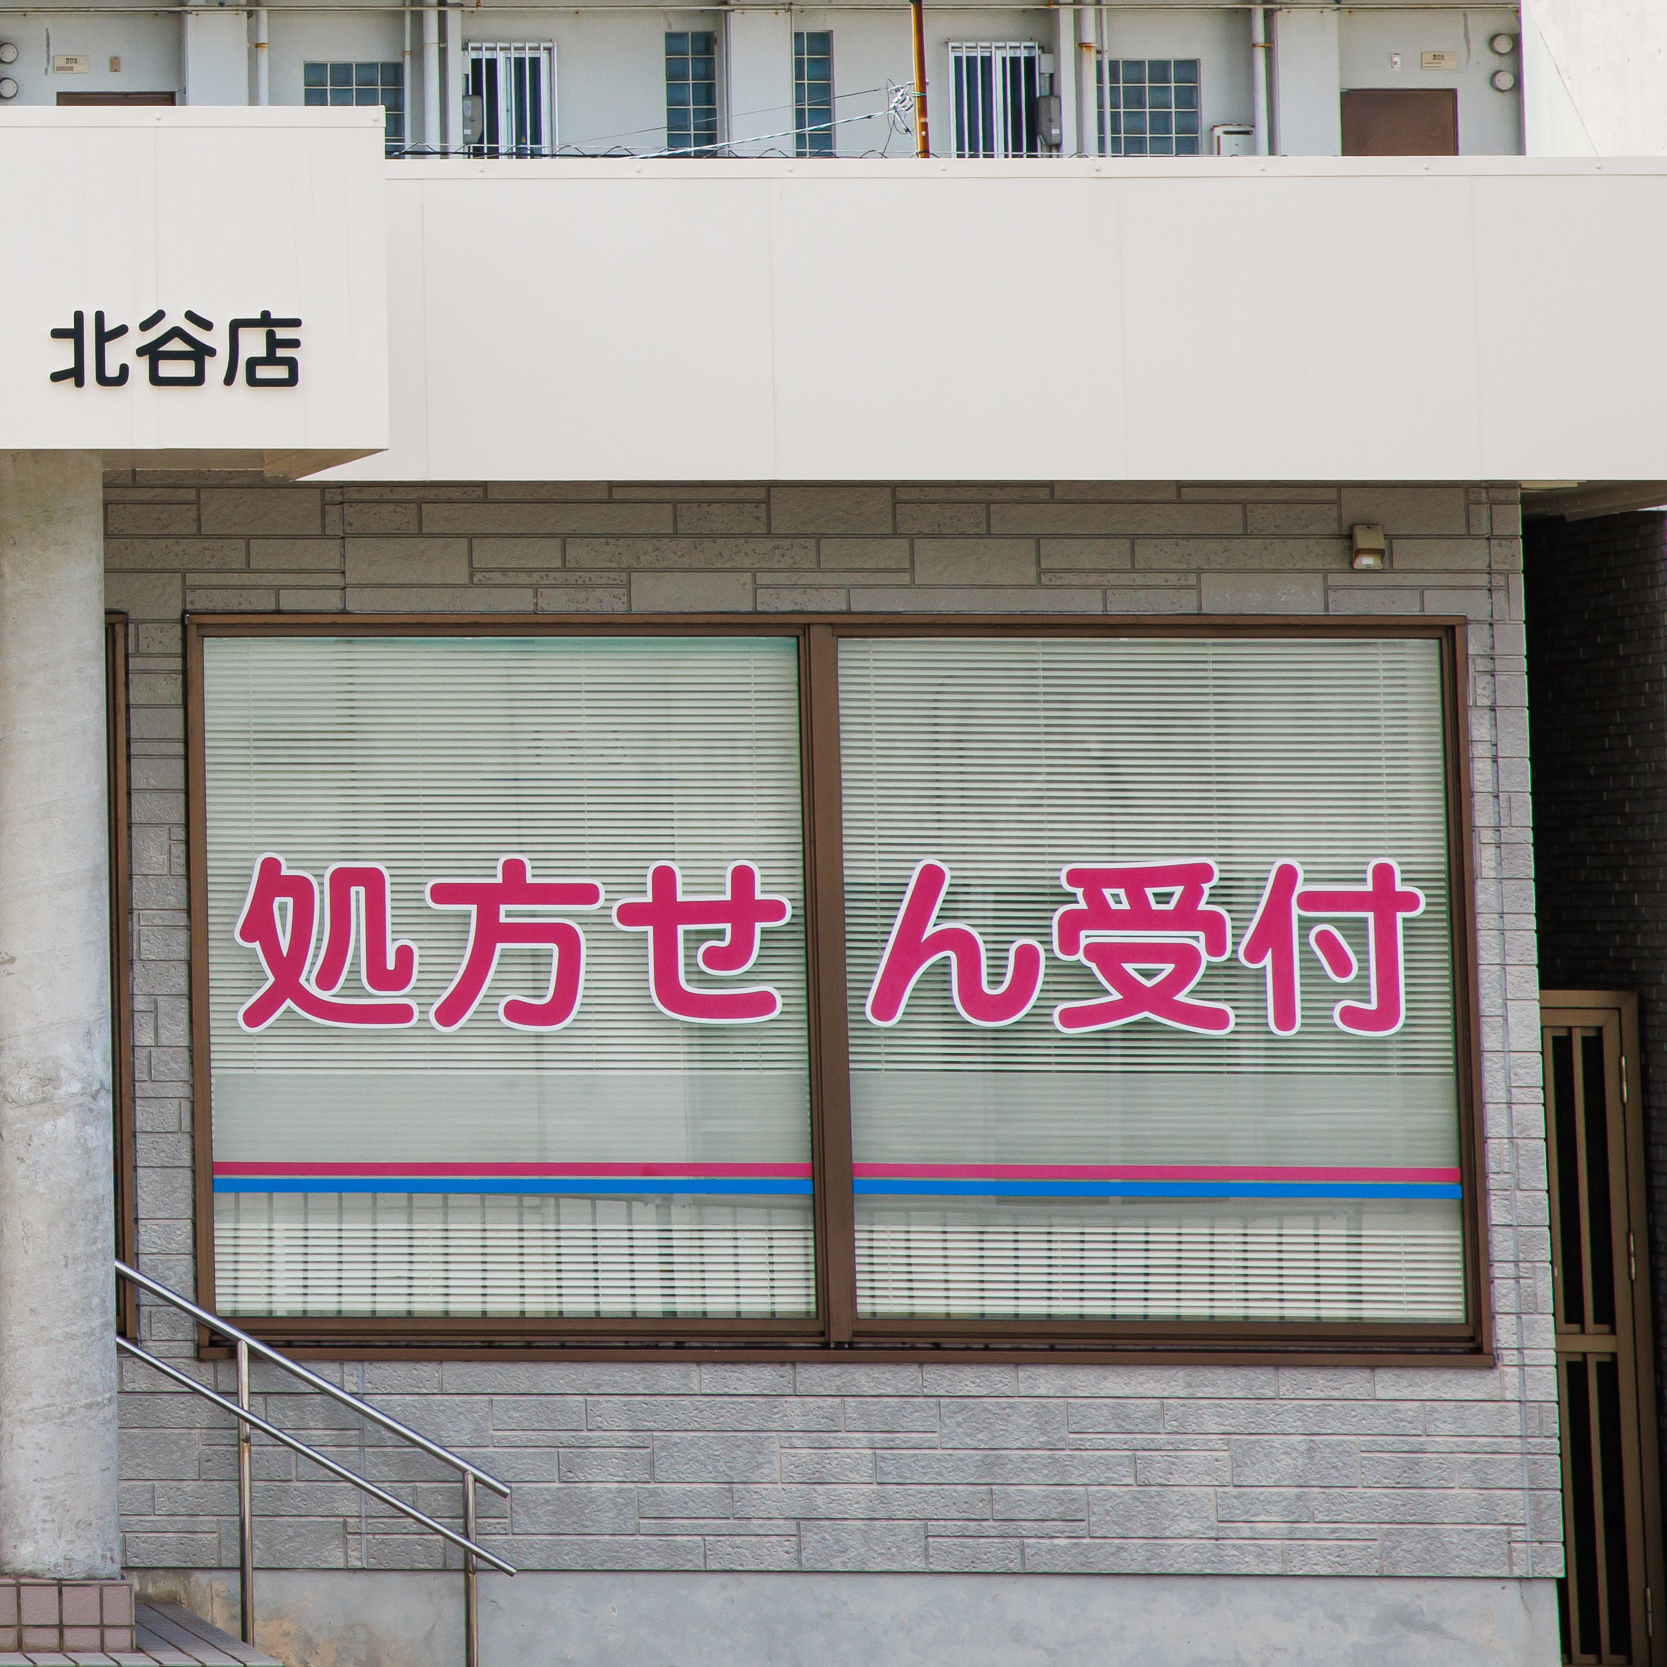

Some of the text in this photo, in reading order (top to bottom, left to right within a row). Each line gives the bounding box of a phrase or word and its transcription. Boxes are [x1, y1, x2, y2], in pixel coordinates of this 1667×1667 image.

[48, 308, 306, 394] 北谷店
[234, 852, 1427, 1038] 処方せん受付
